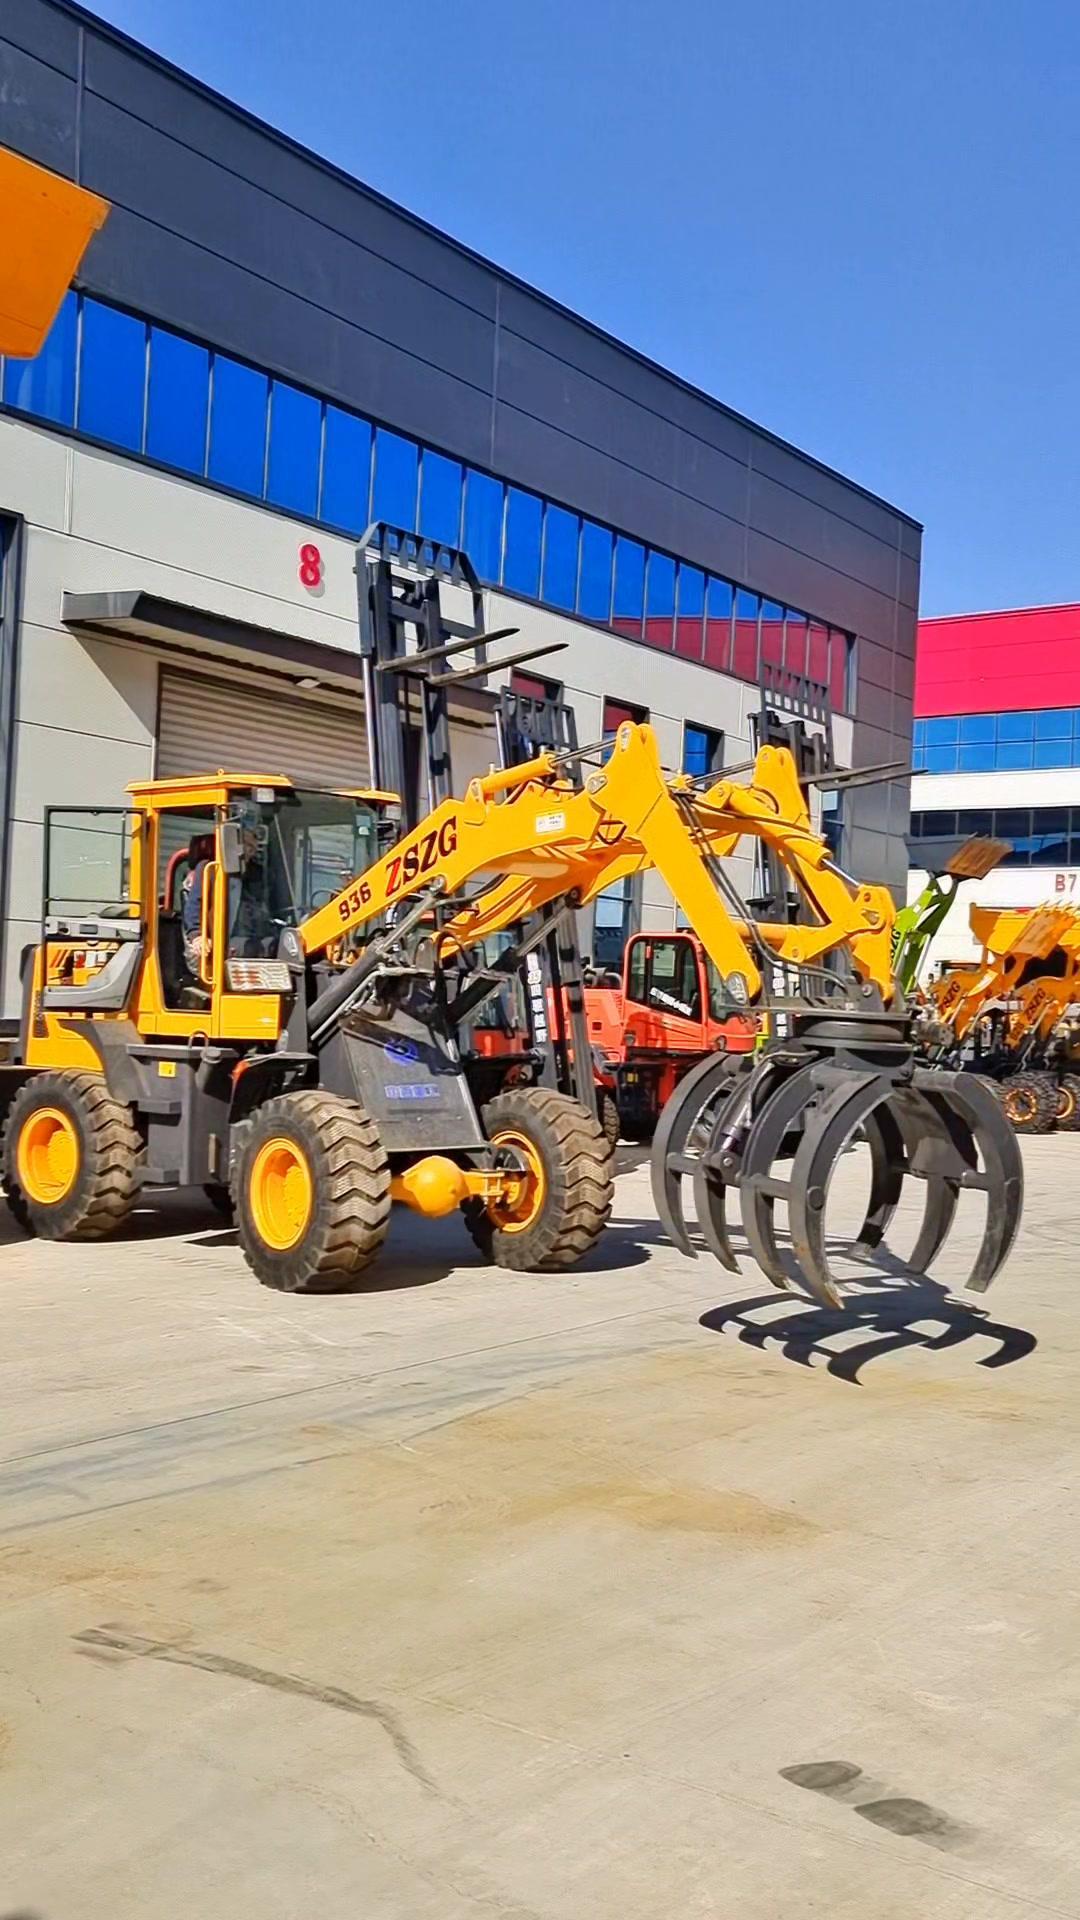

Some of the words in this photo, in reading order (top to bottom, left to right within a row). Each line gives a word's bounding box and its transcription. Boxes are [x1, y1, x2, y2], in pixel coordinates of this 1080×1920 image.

[299, 543, 321, 587] 8
[385, 815, 457, 897] ZSZG
[338, 881, 372, 922] 936
[1055, 873, 1077, 893] B7
